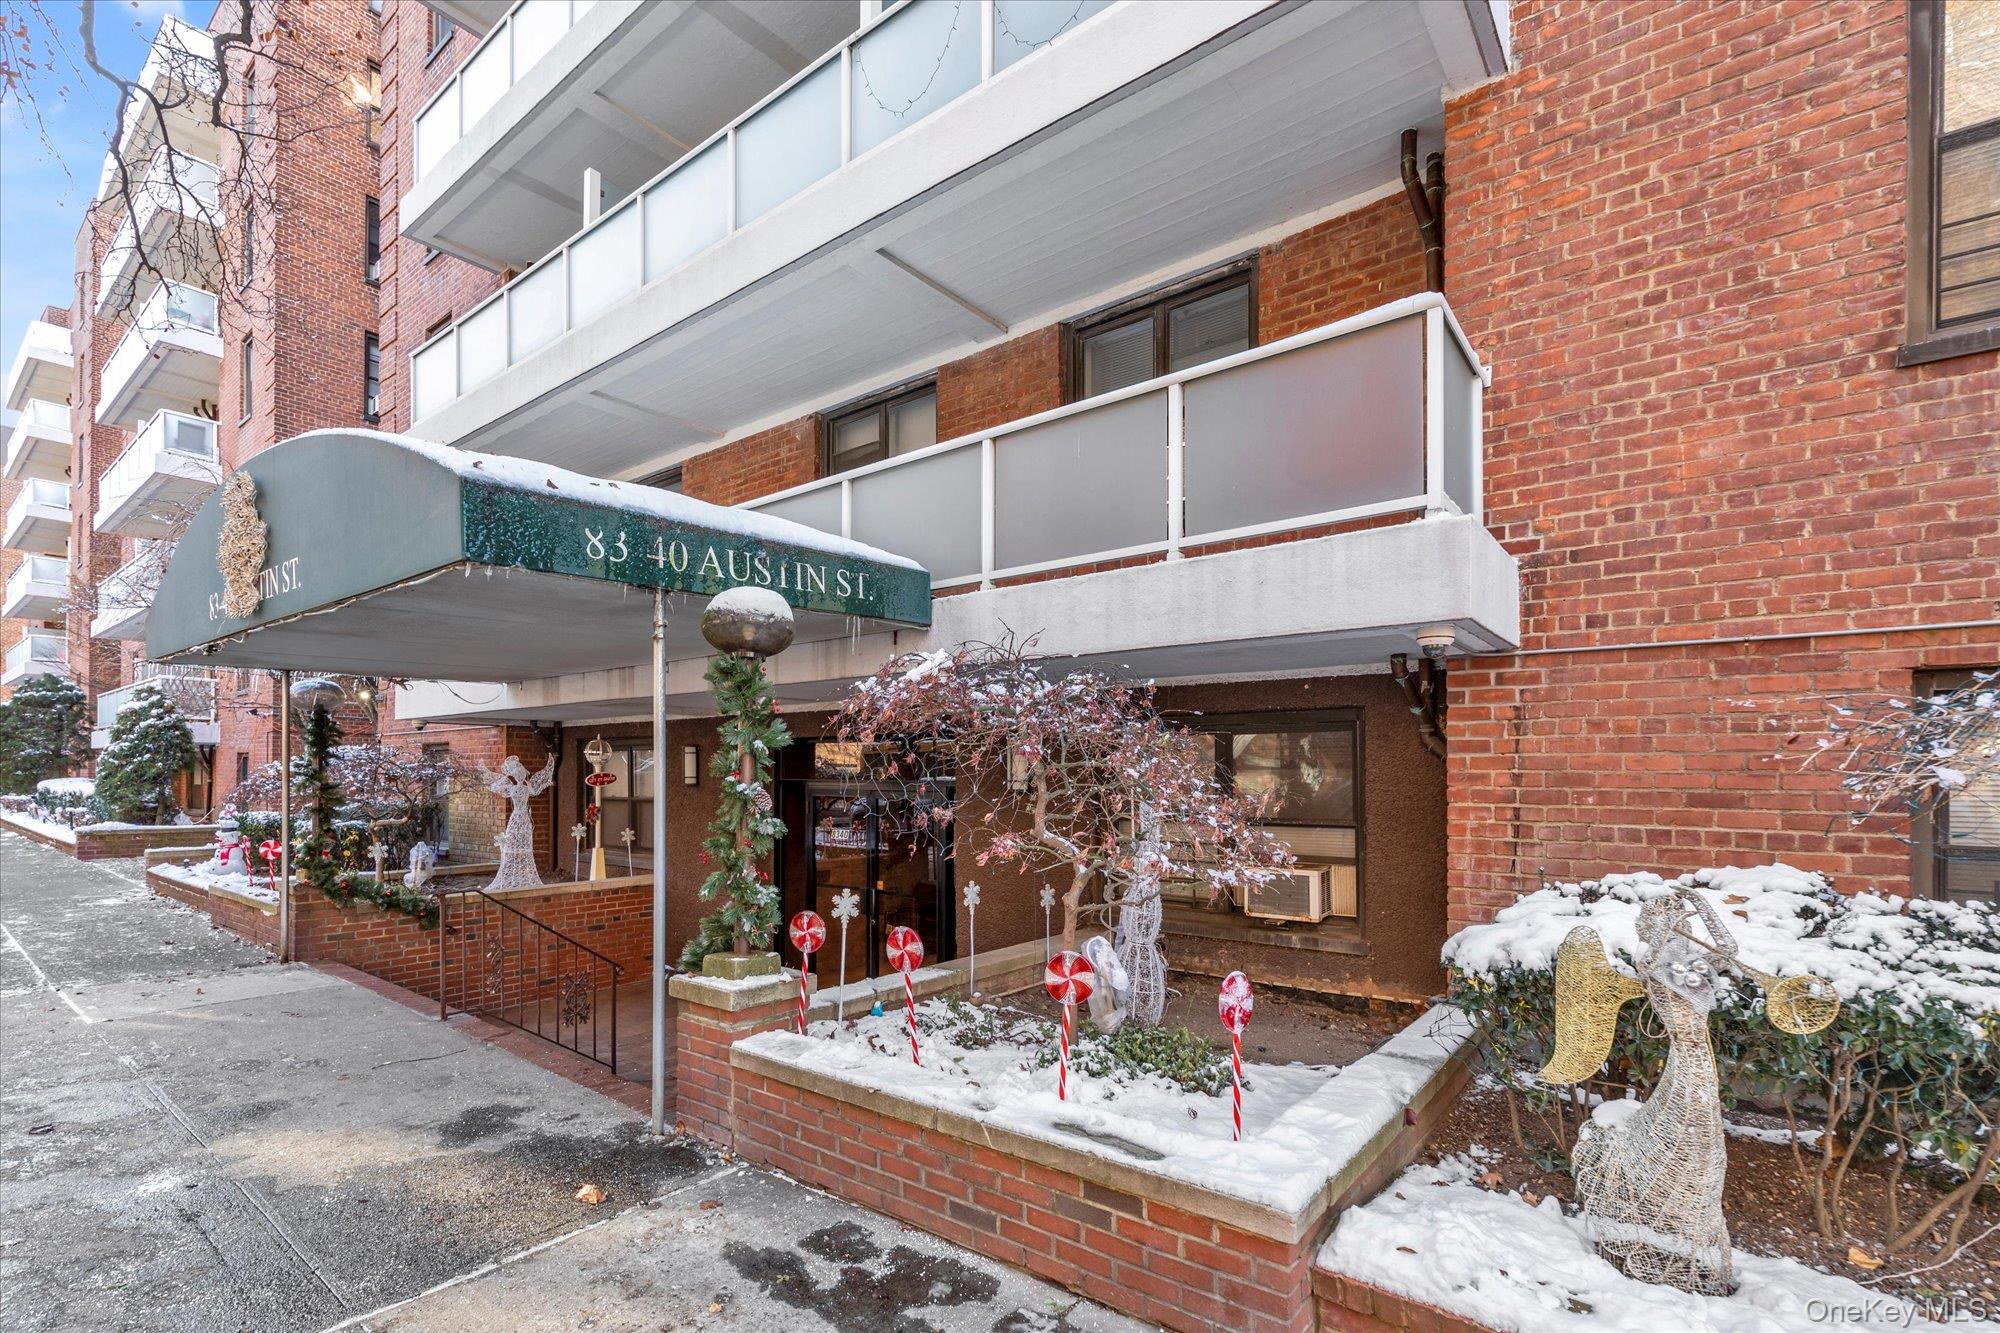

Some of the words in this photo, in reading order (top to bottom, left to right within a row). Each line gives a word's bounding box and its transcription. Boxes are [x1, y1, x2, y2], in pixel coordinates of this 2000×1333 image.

[281, 557, 301, 593] ST.
[698, 545, 827, 594] AUSTIN
[836, 568, 874, 601] ST.
[831, 829, 849, 839] 8340
